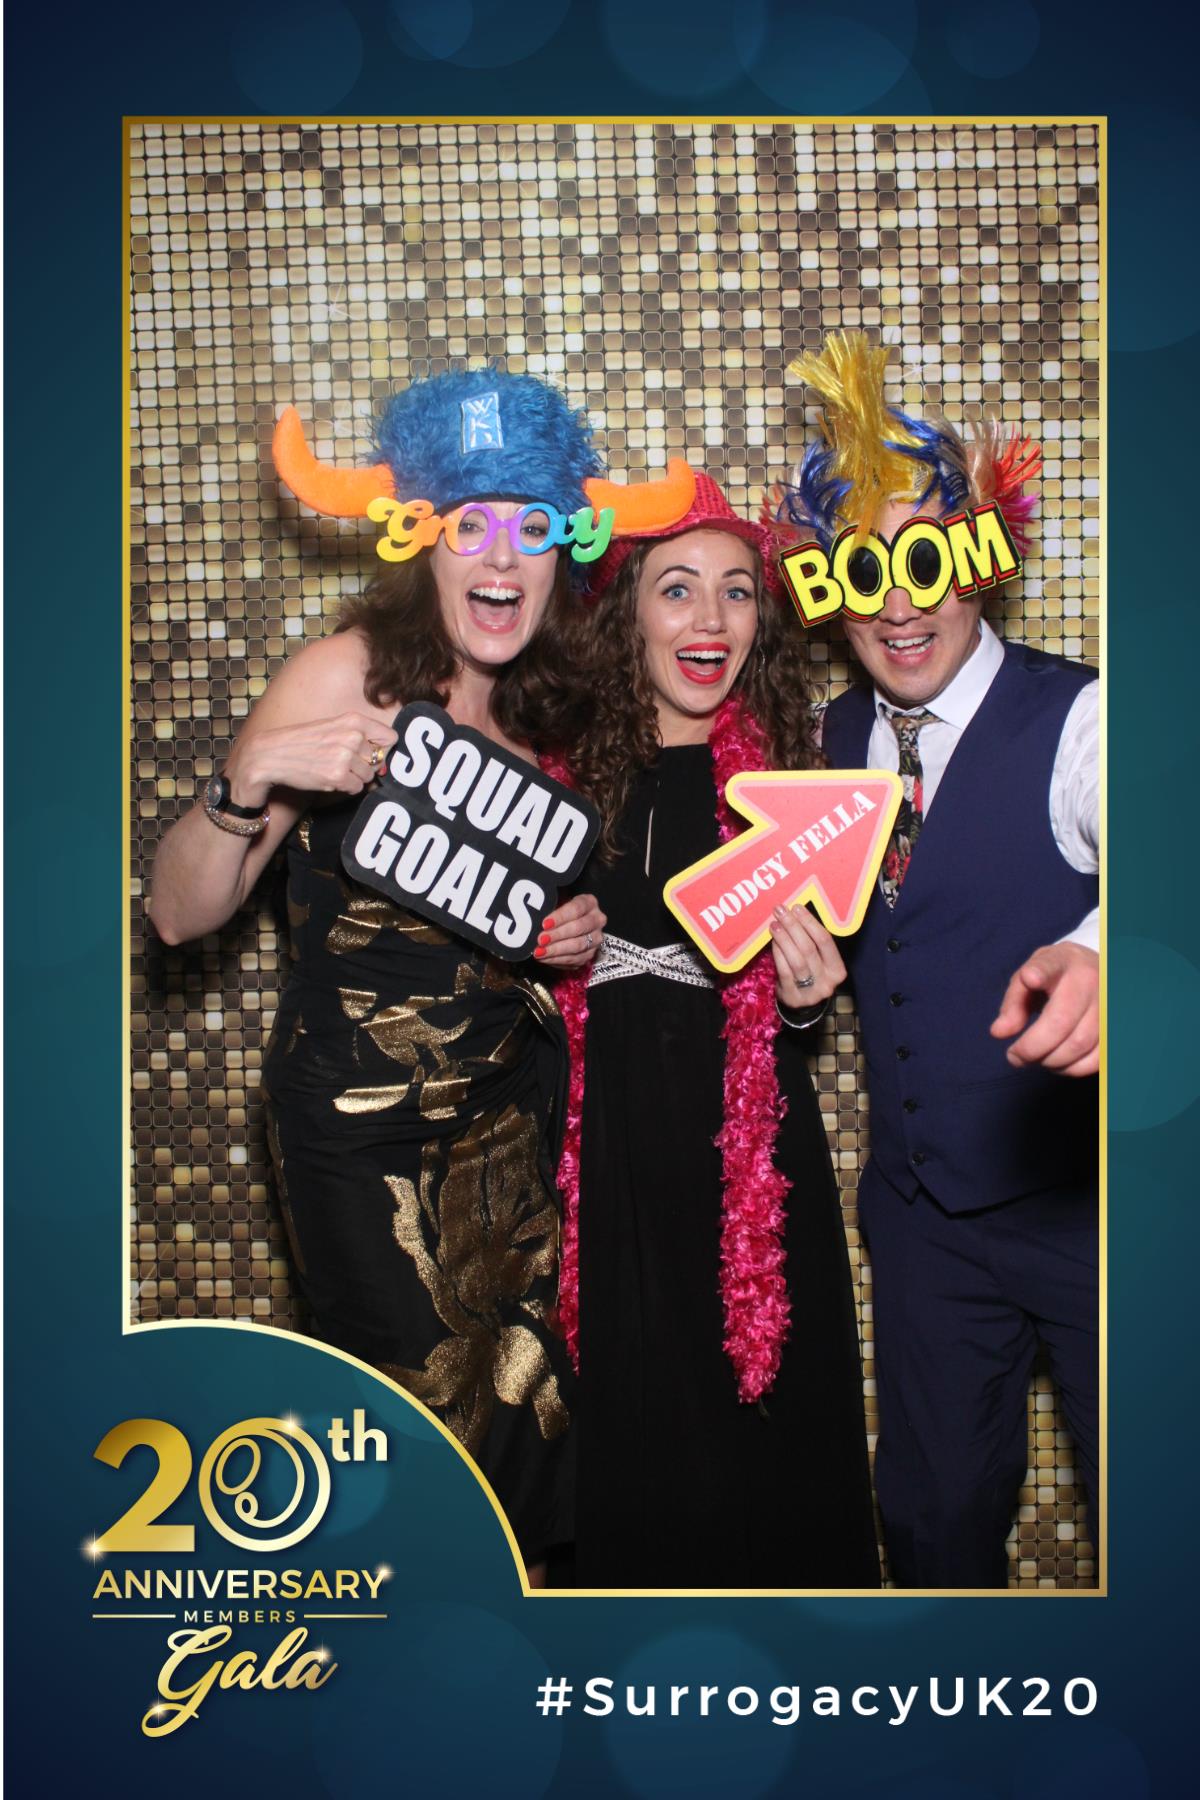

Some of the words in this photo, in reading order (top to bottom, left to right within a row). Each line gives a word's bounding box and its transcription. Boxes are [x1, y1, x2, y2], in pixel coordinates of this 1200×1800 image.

[779, 501, 1022, 628] BOOM
[389, 716, 589, 874] SQUAD
[699, 852, 790, 932] DODGY
[788, 790, 877, 864] FELLA
[354, 801, 546, 949] GOALS
